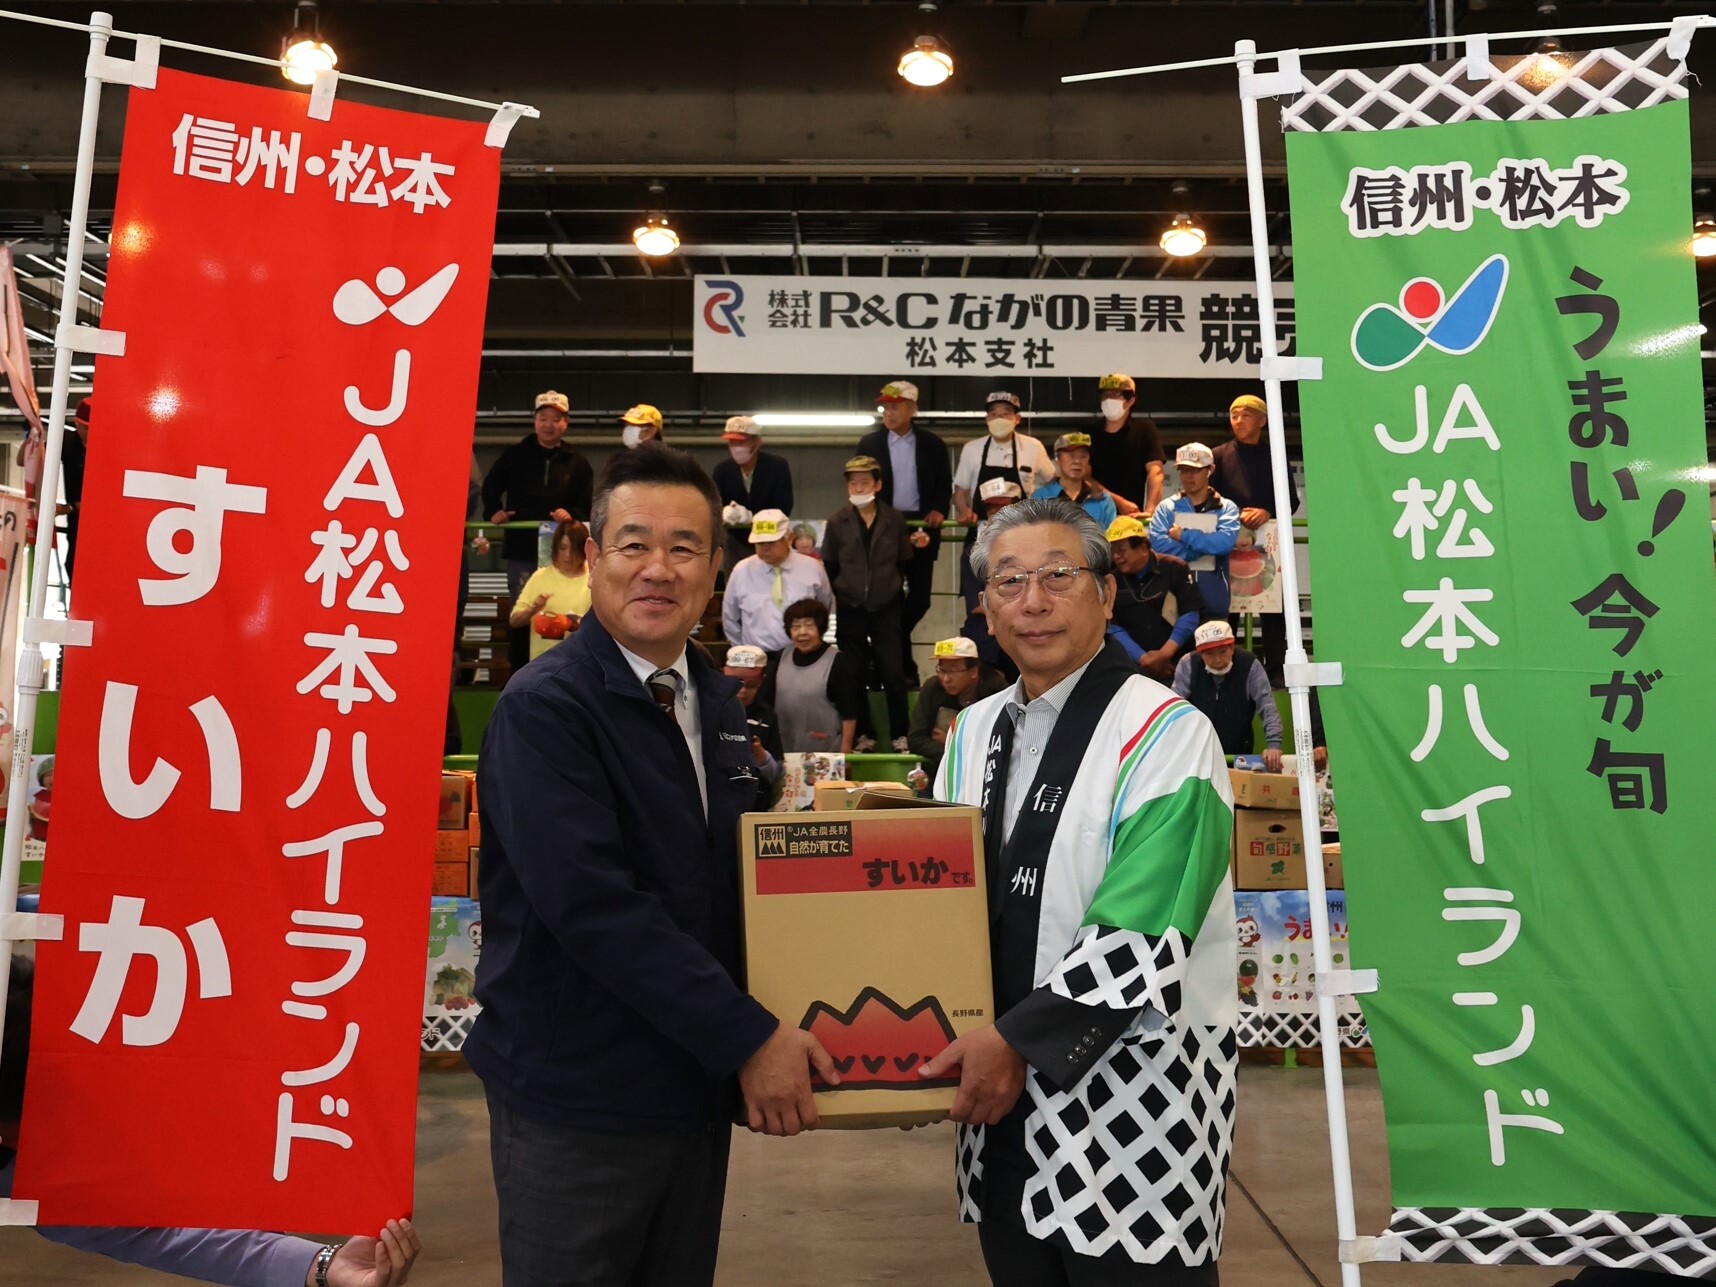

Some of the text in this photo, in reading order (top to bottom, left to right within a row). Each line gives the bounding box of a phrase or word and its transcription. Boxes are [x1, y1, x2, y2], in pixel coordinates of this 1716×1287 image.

[172, 113, 455, 214] 信州・松本
[1347, 161, 1624, 232] 信州・松本
[905, 337, 1055, 369] 松本支社
[69, 464, 268, 1047] すいか
[273, 348, 411, 1182] JA松本ハイランド
[1374, 383, 1564, 1167] JA松本ハイランド
[760, 828, 784, 841] 信州
[789, 840, 850, 855] 自然が育てた
[952, 1009, 984, 1019] 長野県産
